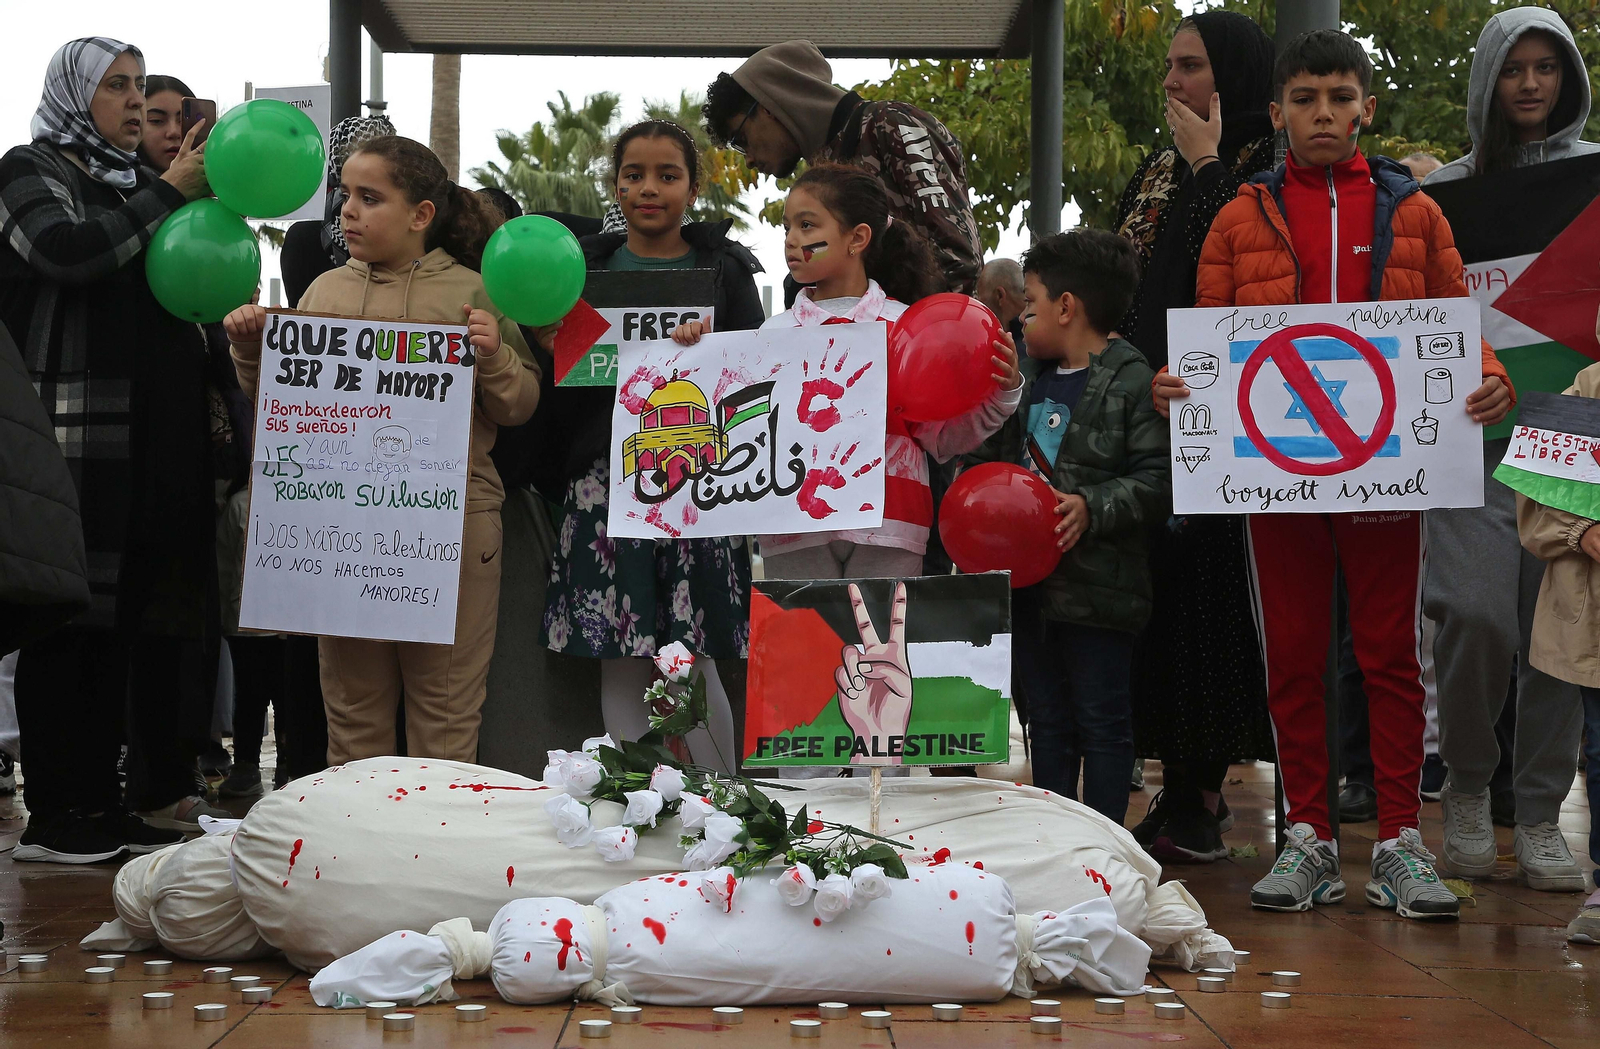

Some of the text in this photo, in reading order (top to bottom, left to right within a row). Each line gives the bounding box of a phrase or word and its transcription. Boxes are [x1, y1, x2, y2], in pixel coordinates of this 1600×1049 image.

[1346, 302, 1447, 331] palestine
[355, 327, 475, 367] QUIERES
[275, 357, 454, 402] SER DE MAYOR?
[414, 435, 431, 446] de
[262, 444, 304, 479] LES
[340, 461, 360, 471] no
[1216, 467, 1429, 511] boycott israel
[255, 552, 282, 569] NO
[288, 557, 323, 575] NOS
[360, 583, 440, 607] MAYORES!
[756, 732, 986, 759] FREE PALESTINE
